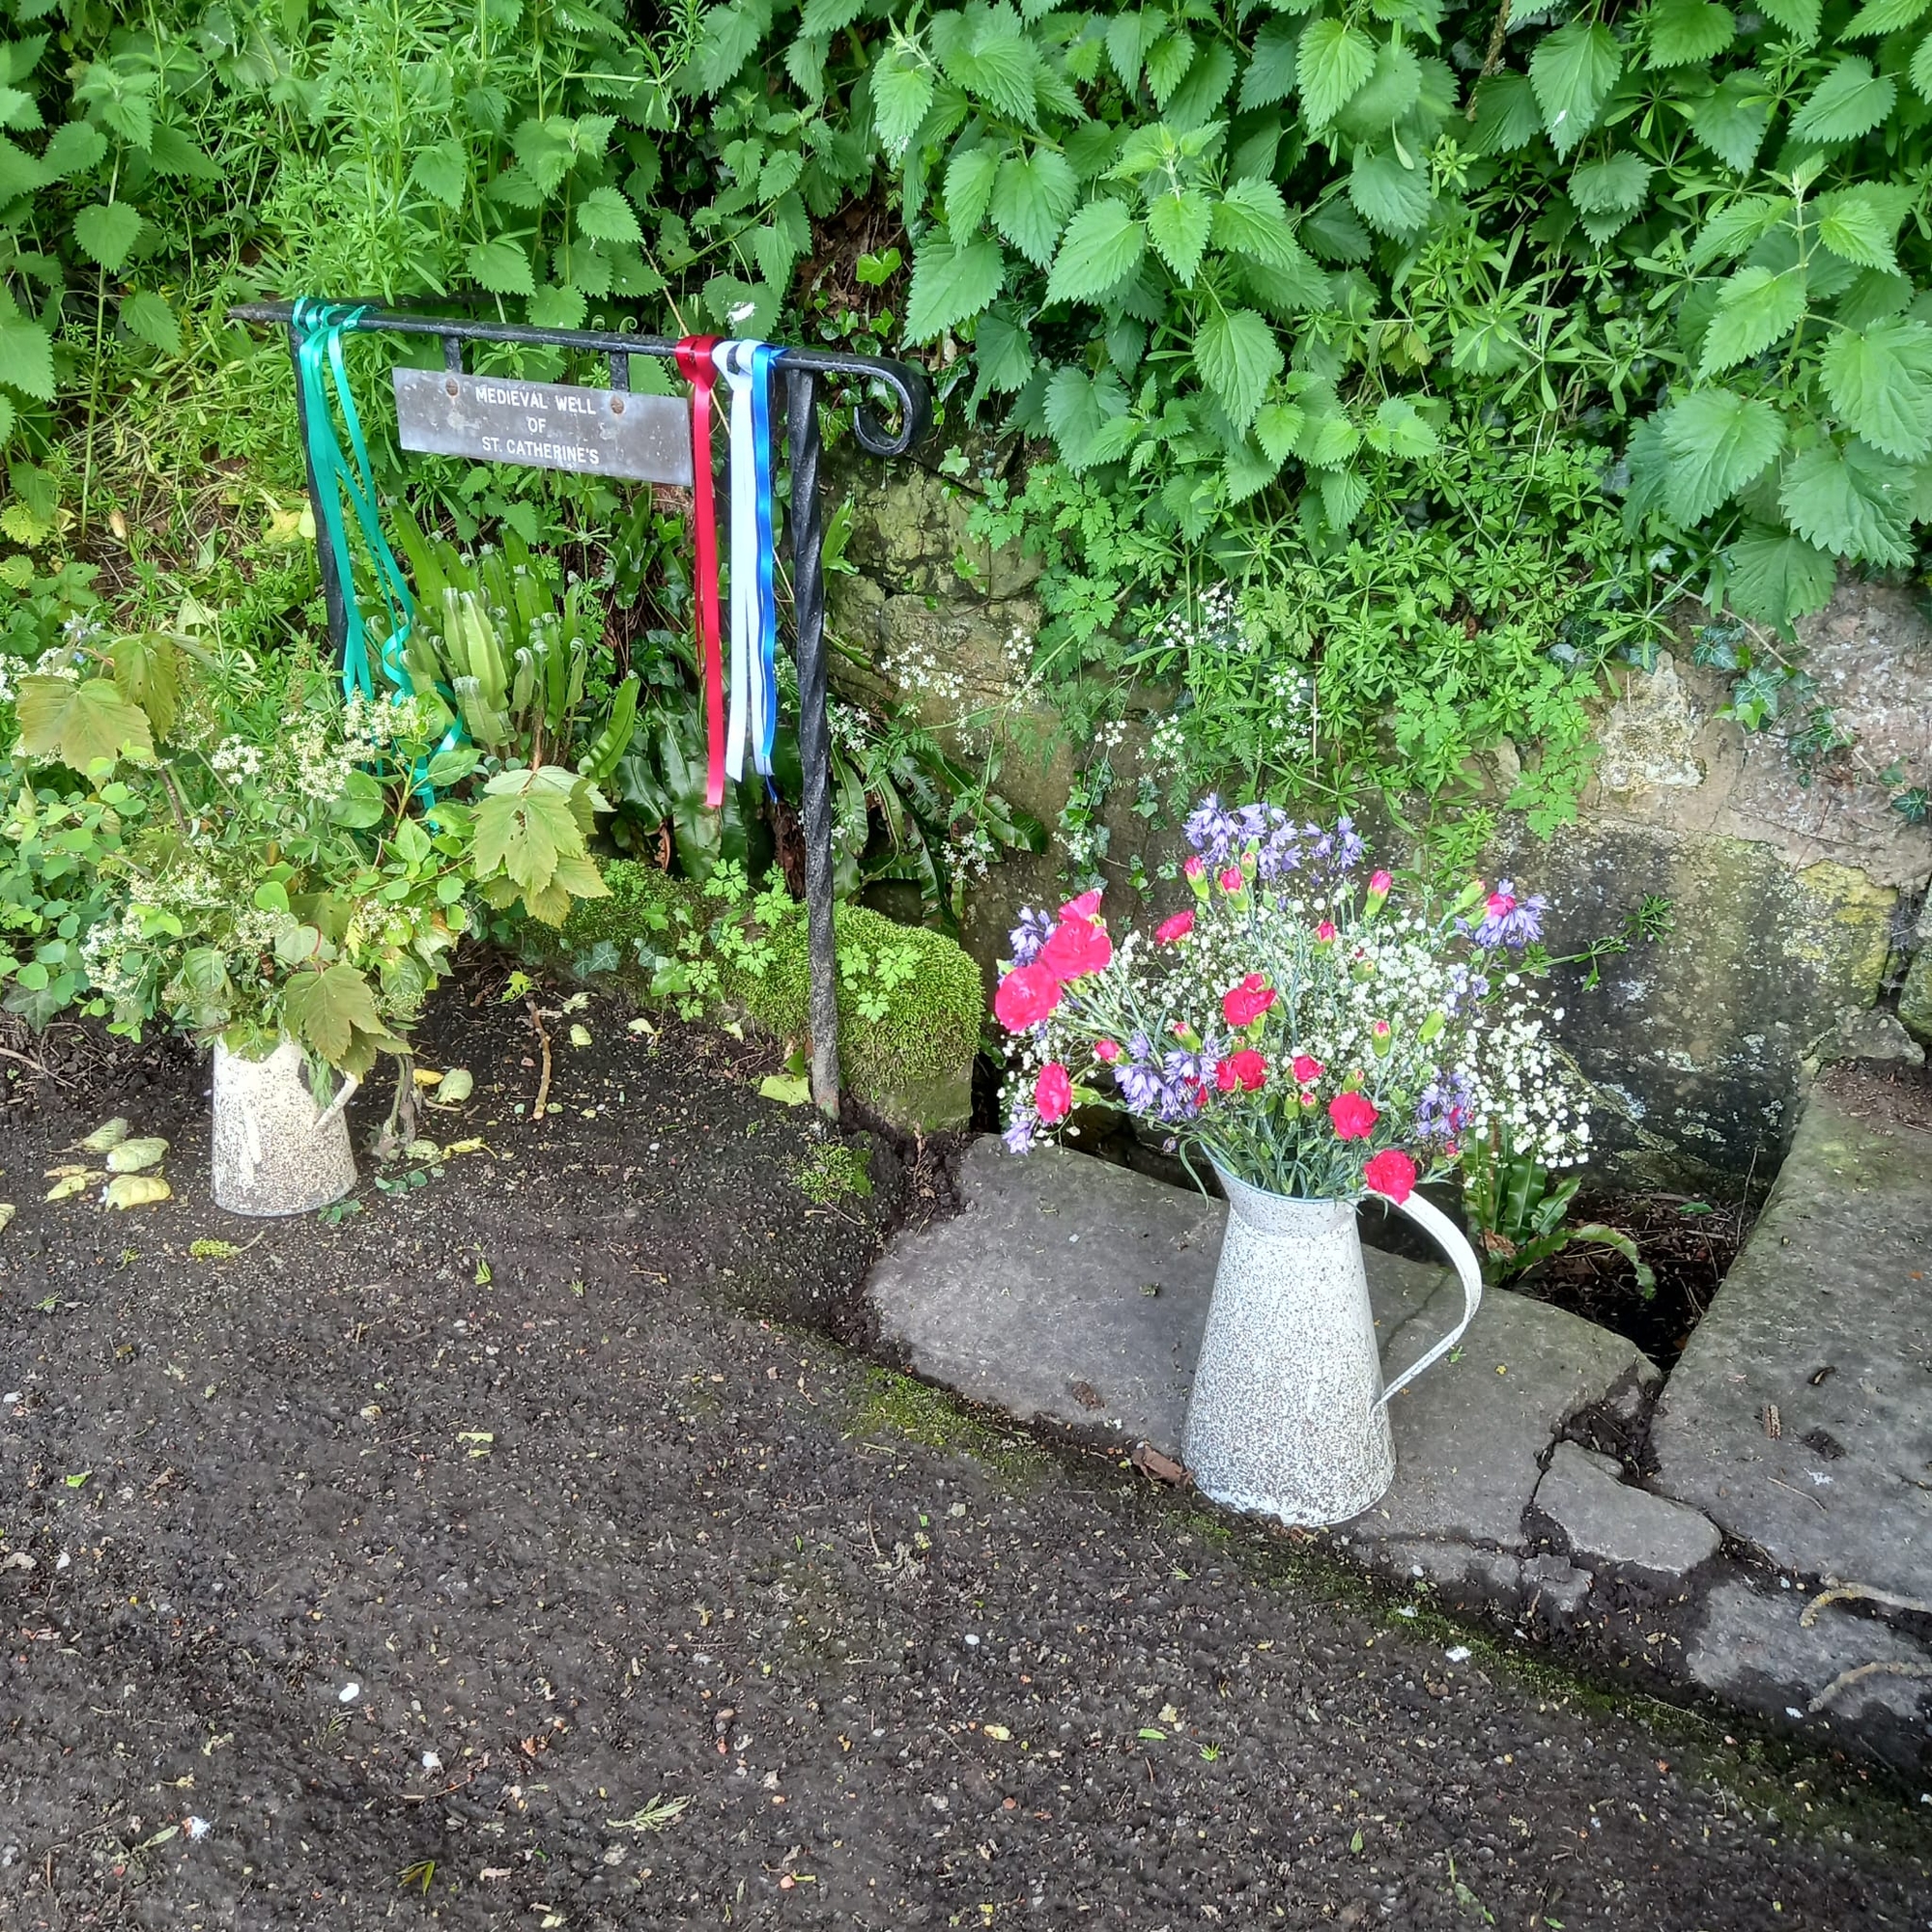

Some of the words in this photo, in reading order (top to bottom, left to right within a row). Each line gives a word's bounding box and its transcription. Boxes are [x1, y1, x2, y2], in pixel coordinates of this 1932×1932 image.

[475, 386, 548, 410] MEDIEVAL
[555, 395, 597, 414] WELL
[527, 416, 546, 434] OF
[482, 436, 503, 453] ST.
[506, 439, 599, 465] CATHERINE'S
